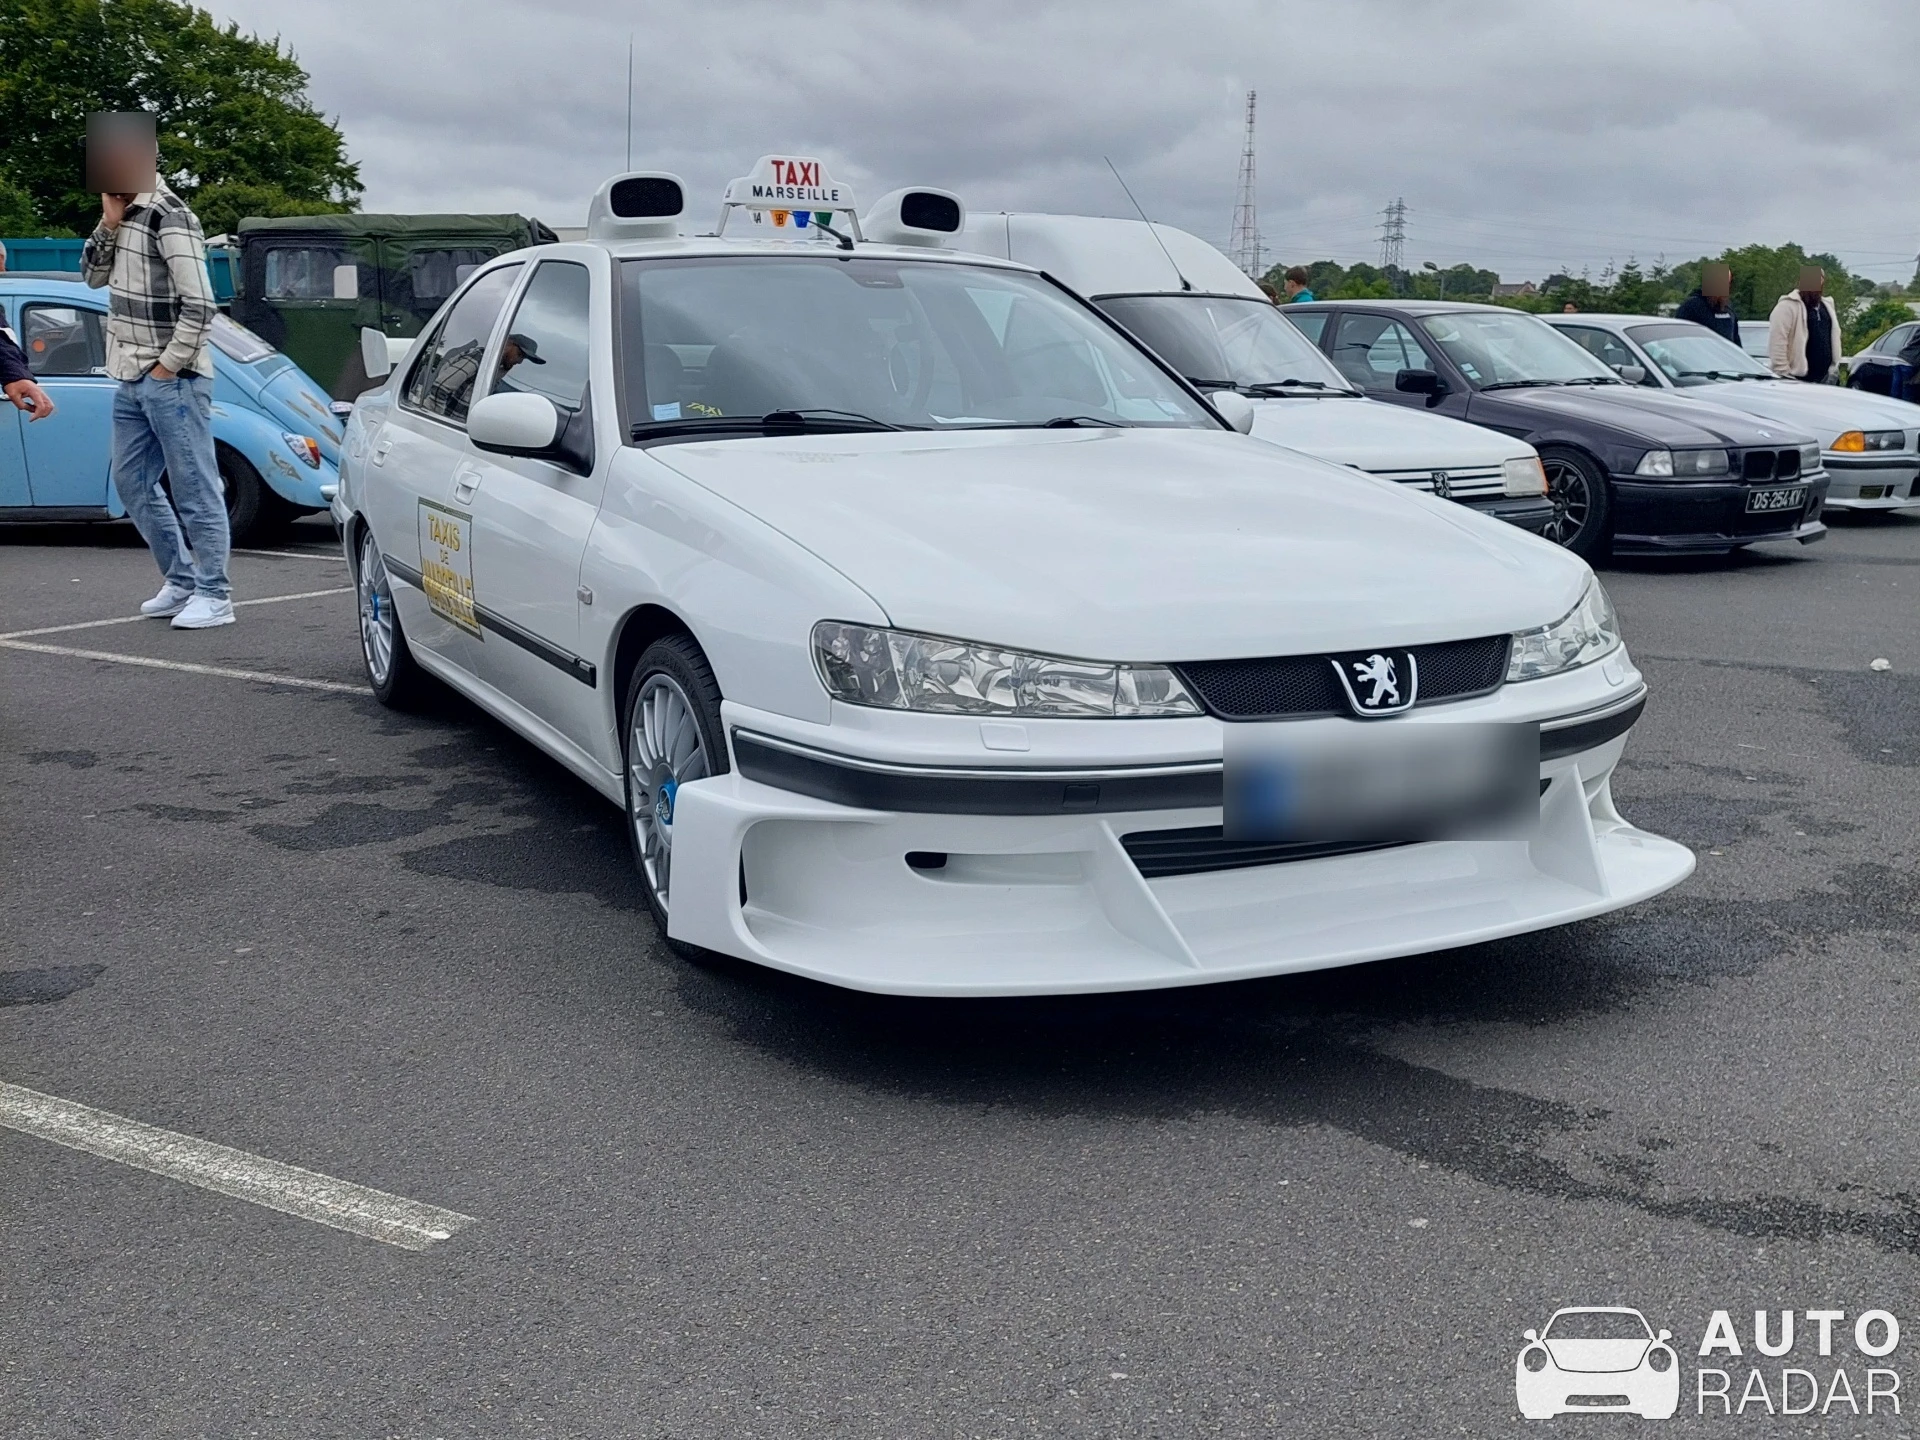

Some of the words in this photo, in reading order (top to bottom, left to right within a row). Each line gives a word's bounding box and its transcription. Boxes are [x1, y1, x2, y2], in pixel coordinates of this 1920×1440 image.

[771, 160, 820, 187] TAXI
[752, 185, 839, 202] MARSEILLE
[427, 513, 461, 552] TAXIS
[439, 548, 450, 566] DE
